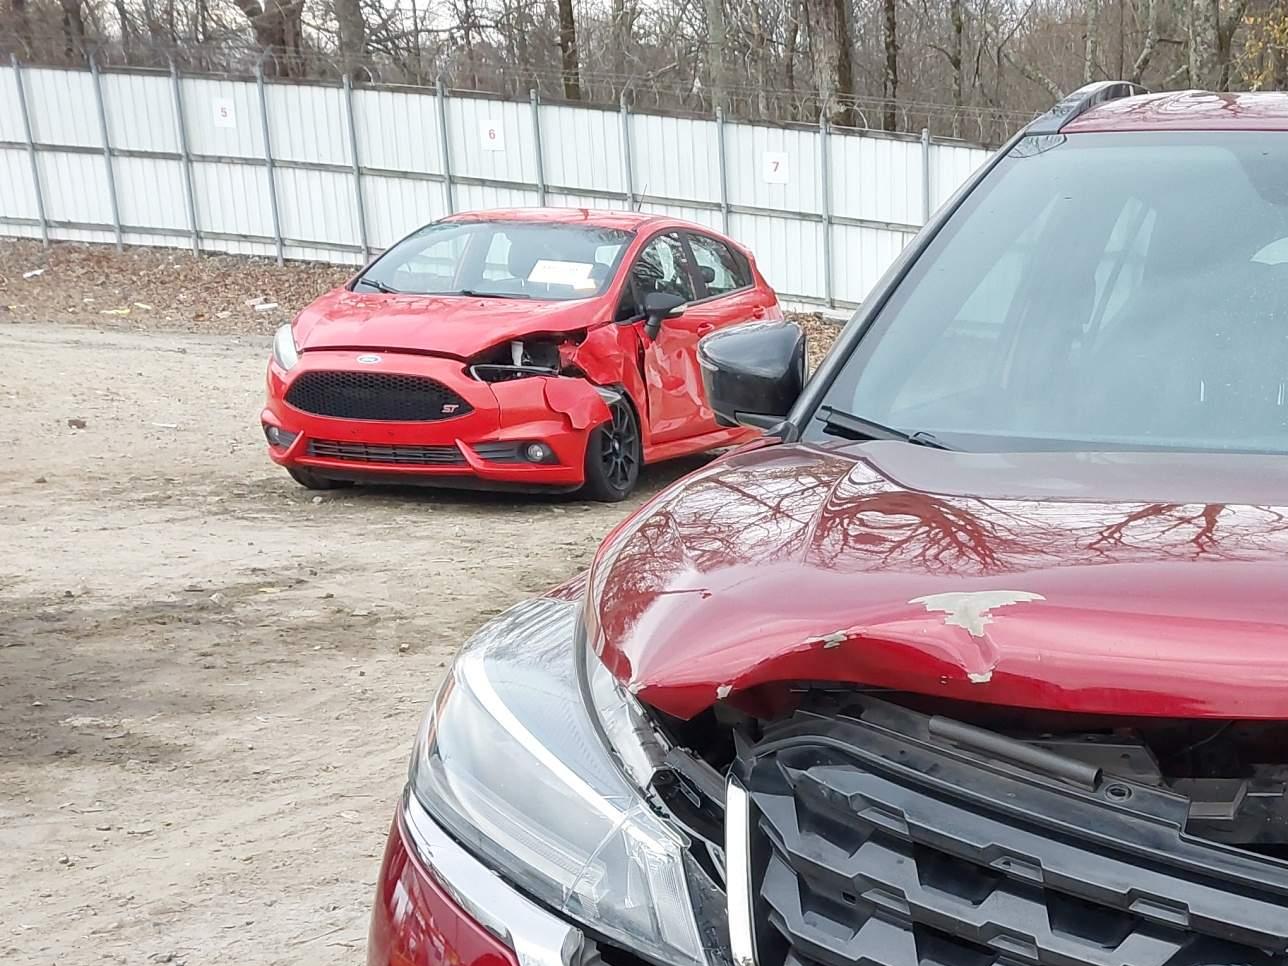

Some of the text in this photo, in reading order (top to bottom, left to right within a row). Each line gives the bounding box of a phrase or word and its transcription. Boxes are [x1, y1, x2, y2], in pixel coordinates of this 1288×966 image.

[220, 107, 228, 118] 5
[488, 128, 496, 140] 6
[771, 161, 780, 172] 7
[441, 404, 459, 413] ST
